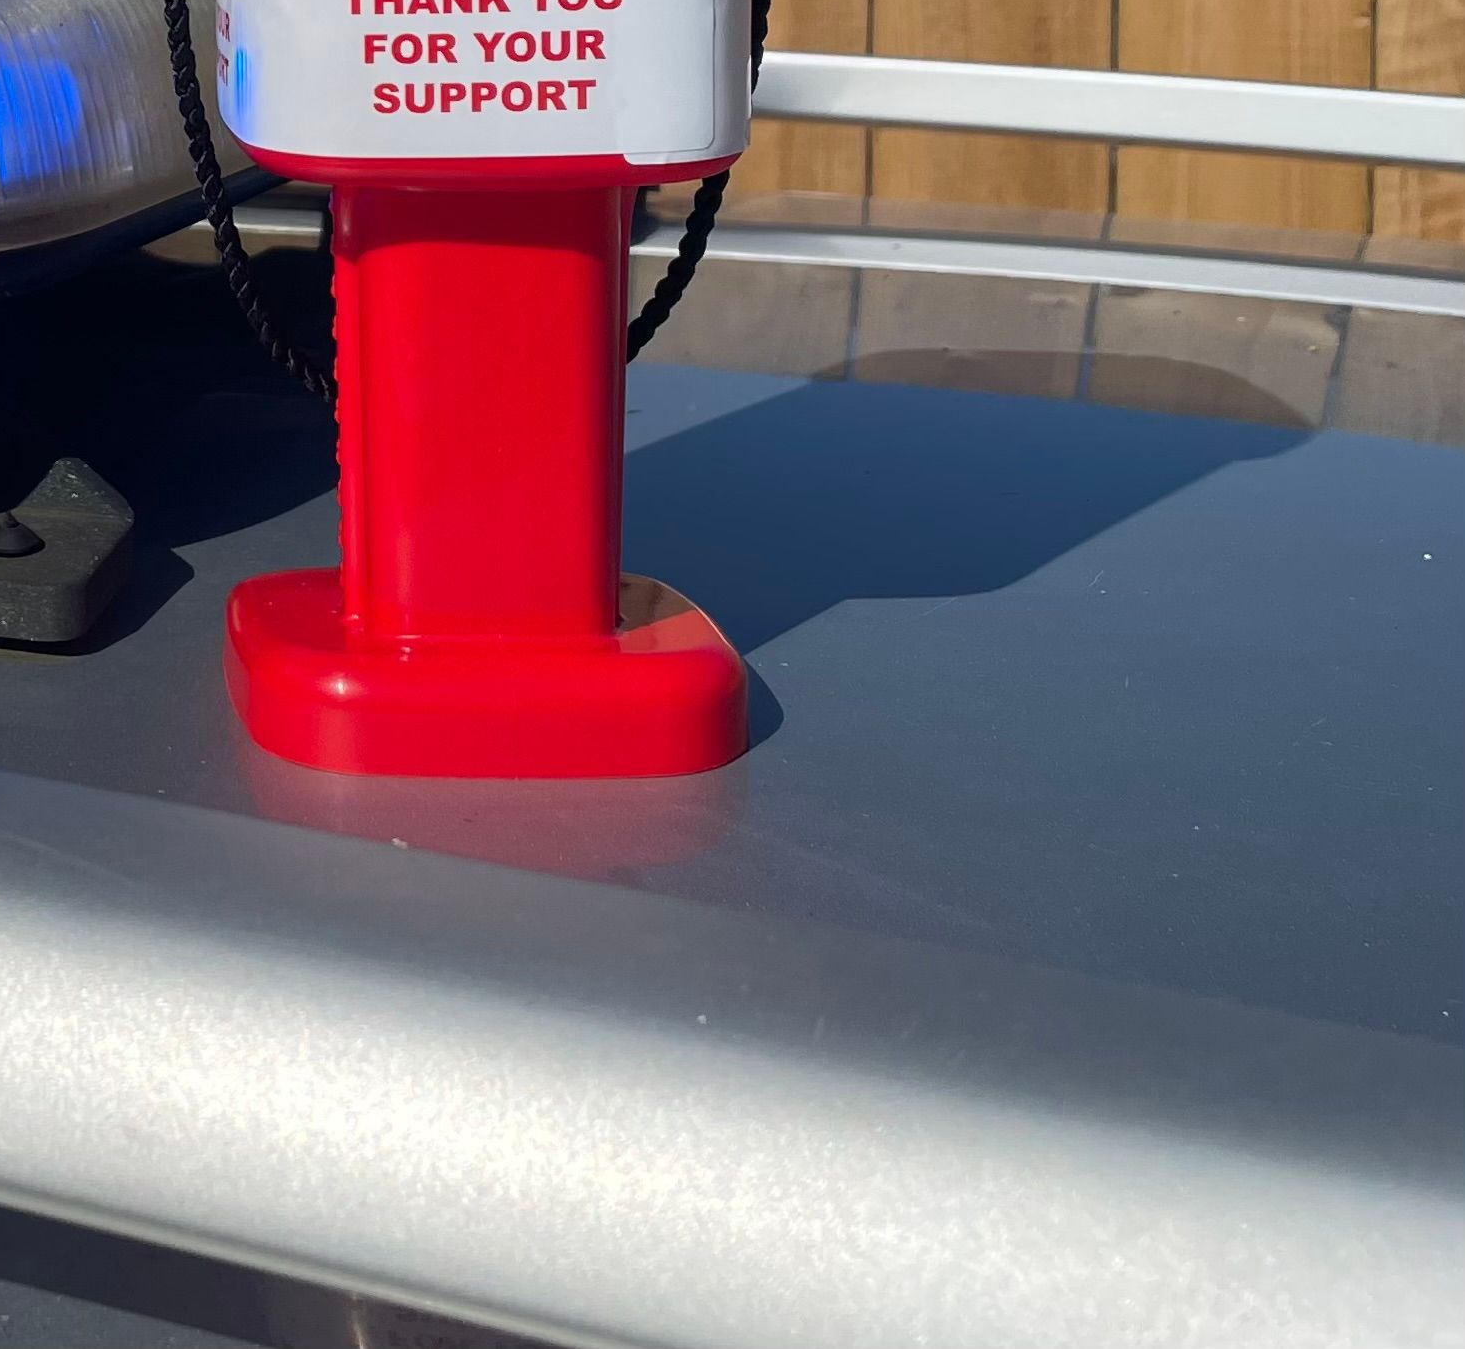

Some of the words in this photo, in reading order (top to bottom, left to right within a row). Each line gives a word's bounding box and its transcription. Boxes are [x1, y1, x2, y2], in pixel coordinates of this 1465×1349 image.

[363, 31, 457, 65] FOR
[474, 28, 605, 63] YOUR
[373, 78, 597, 115] SUPPORT
